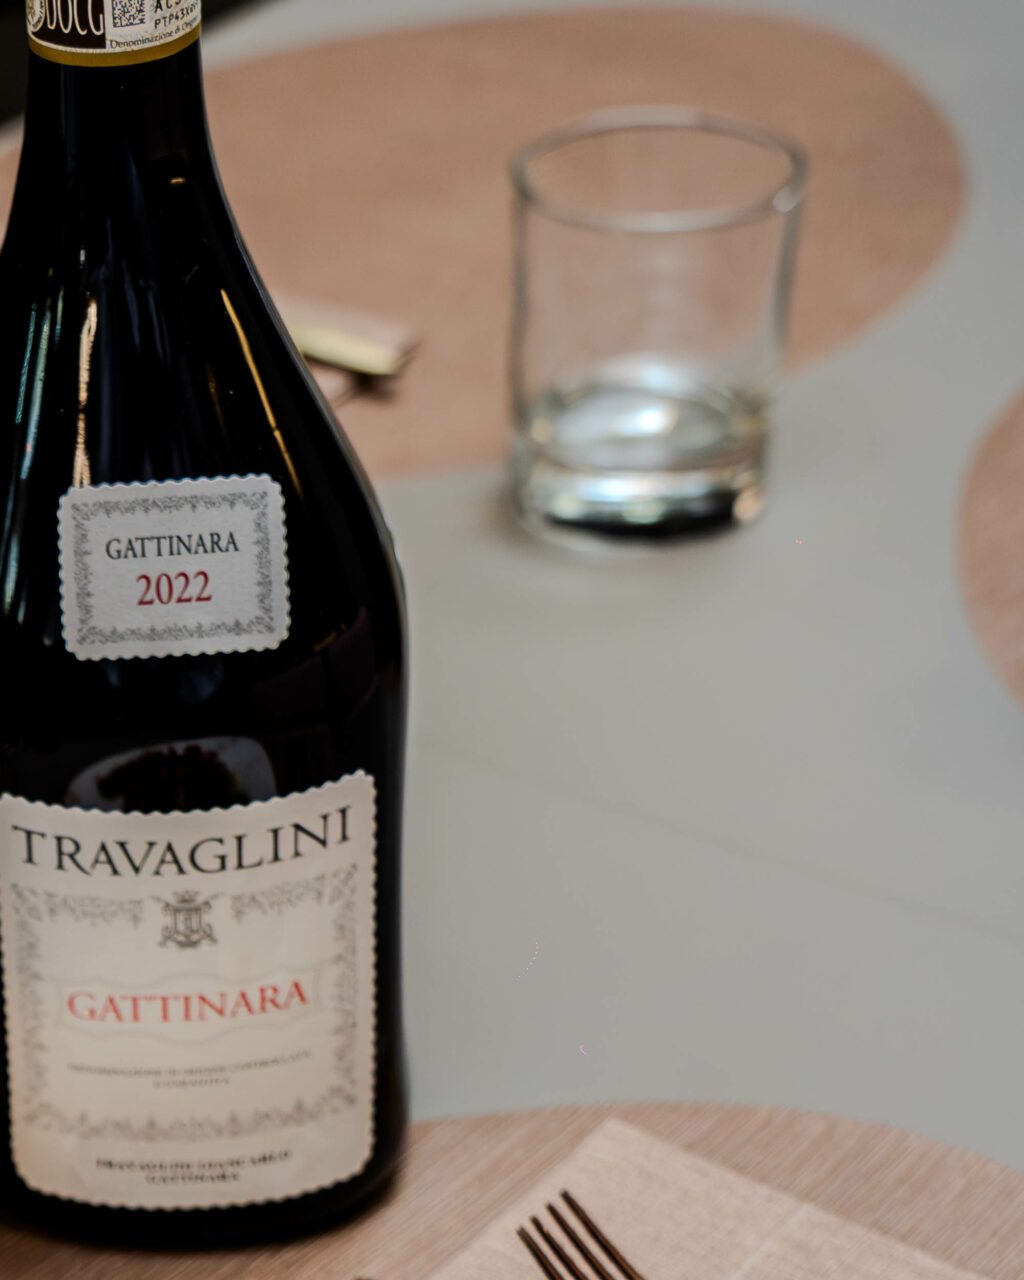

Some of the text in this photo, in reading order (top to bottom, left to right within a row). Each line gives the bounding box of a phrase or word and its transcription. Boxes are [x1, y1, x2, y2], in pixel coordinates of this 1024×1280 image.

[105, 531, 240, 560] GATTINARA
[136, 570, 213, 606] 2022
[11, 806, 352, 877] TRAVAGLINI
[67, 980, 309, 1023] GATTINARA
